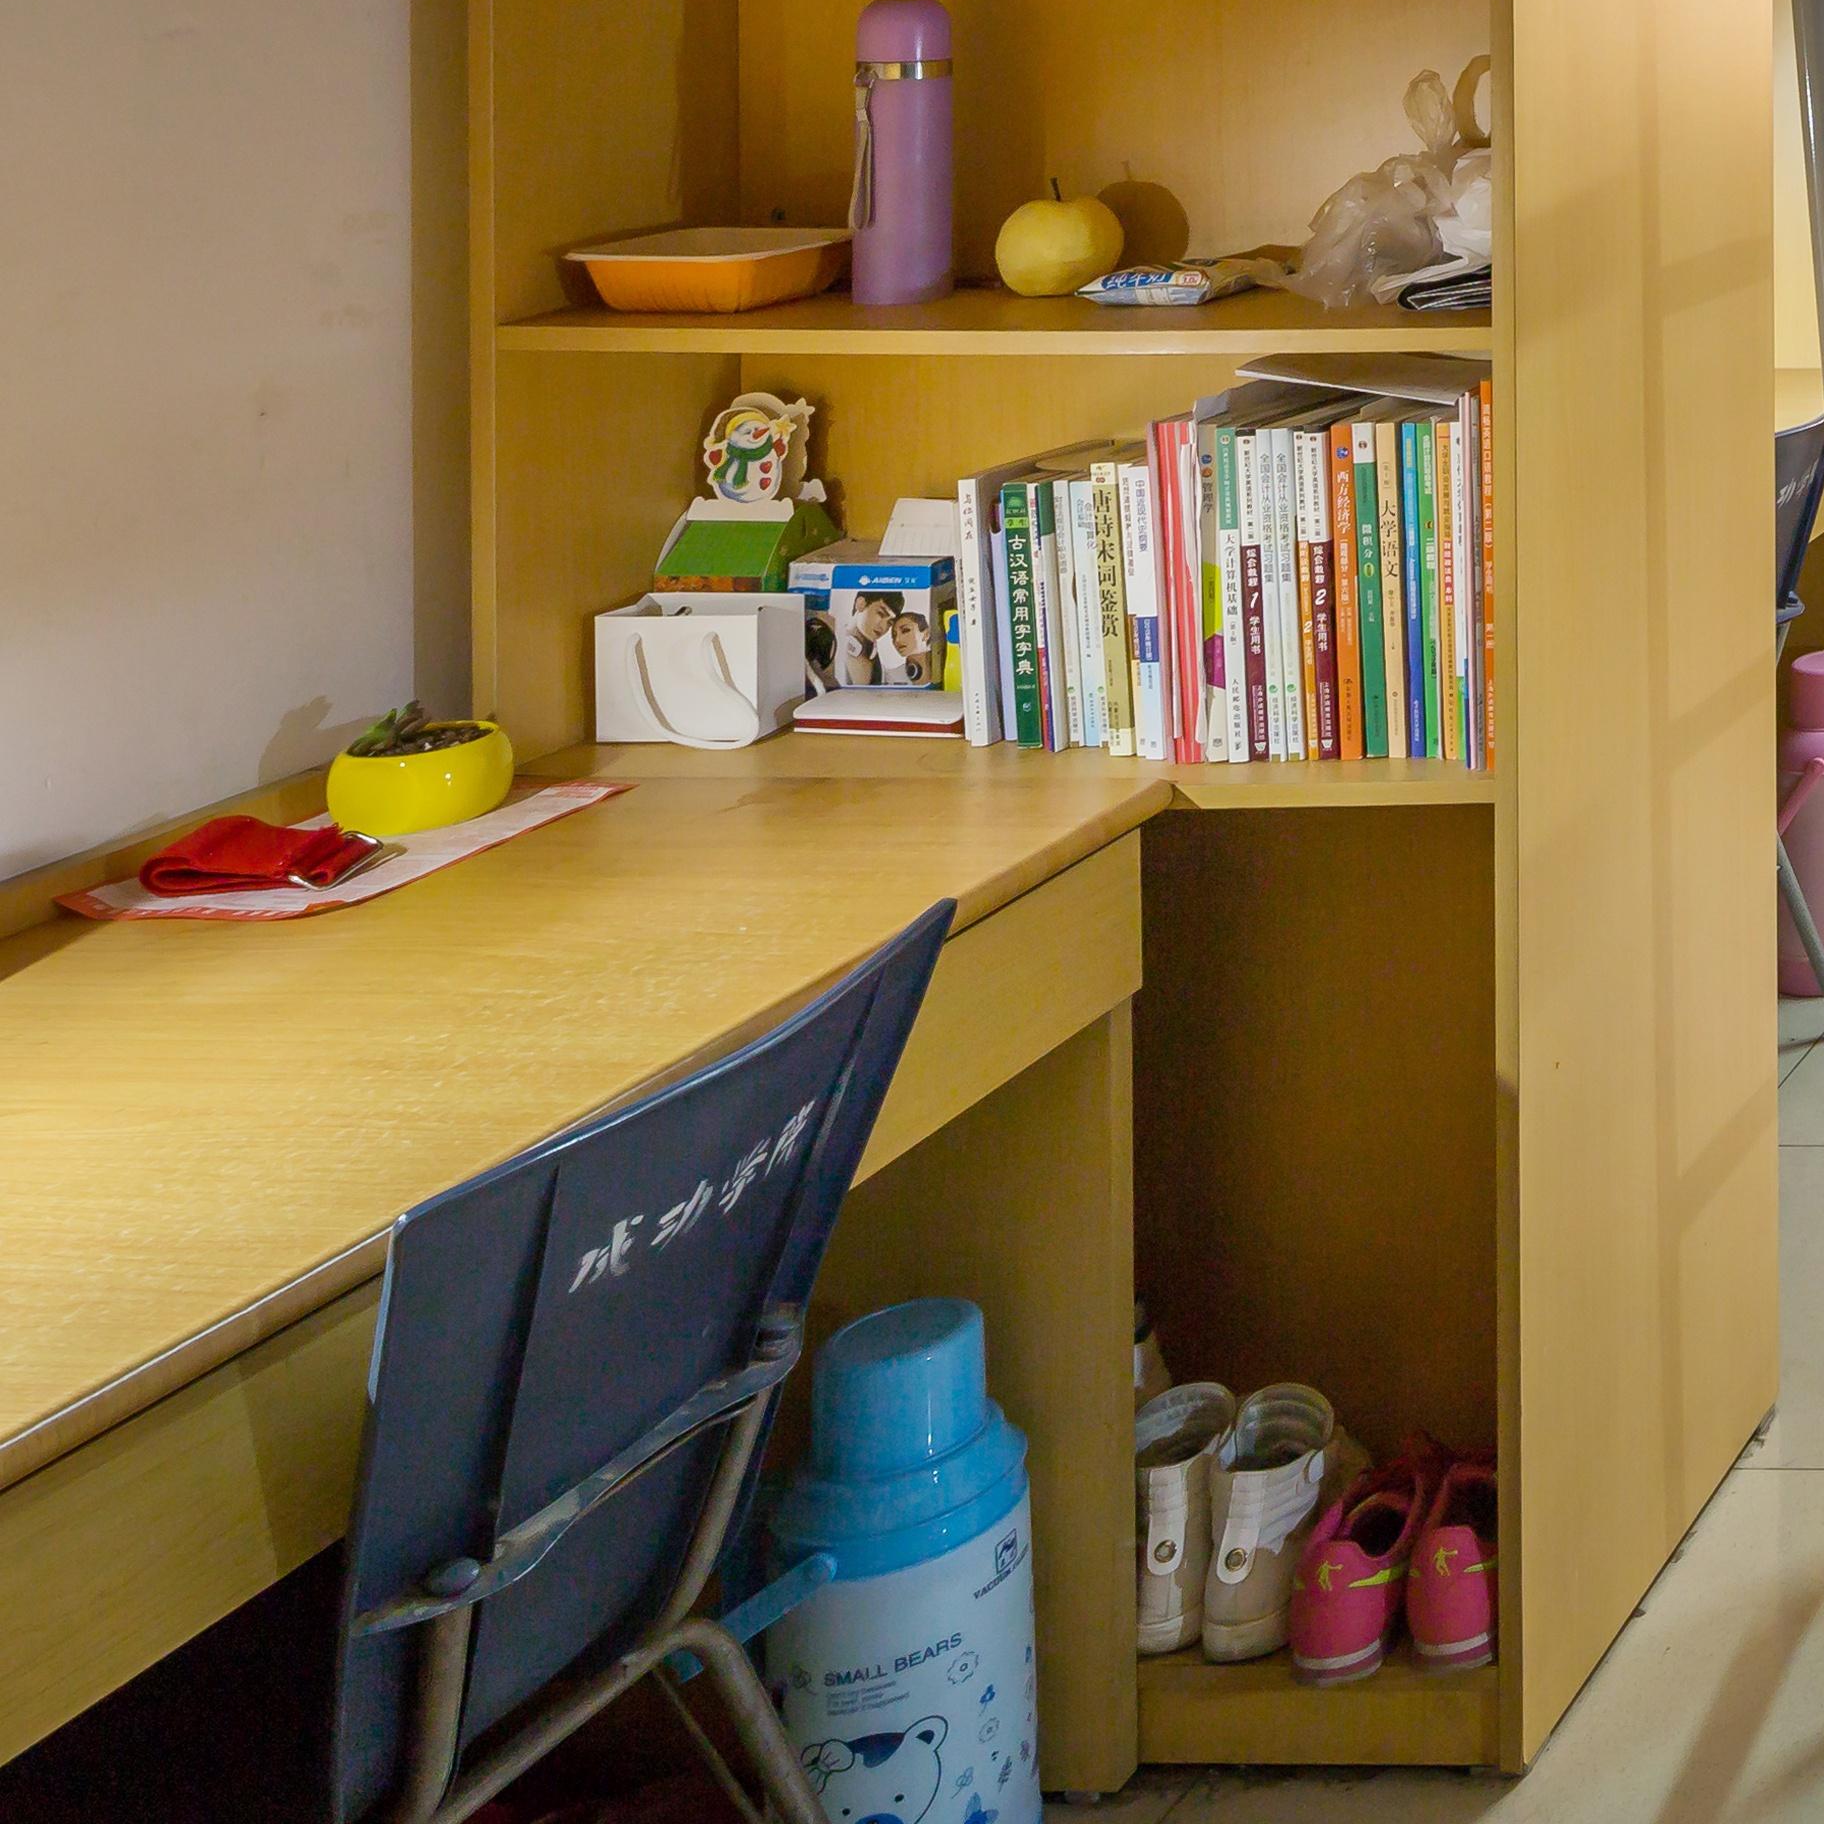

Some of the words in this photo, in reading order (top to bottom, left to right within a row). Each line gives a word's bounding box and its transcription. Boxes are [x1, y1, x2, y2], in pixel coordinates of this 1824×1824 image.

[1336, 470, 1351, 535] 西方经济学
[1361, 523, 1374, 559] 微积分
[1380, 499, 1399, 578] 大学语文
[1224, 533, 1238, 616] 大学计算机基础
[1313, 544, 1325, 584] 综合教程
[1008, 534, 1035, 675] 古汉语常用字字典
[1250, 591, 1259, 609] 1
[1315, 588, 1327, 606] 2
[1249, 615, 1262, 655] 学生用书
[1316, 612, 1328, 653] 学生用书
[823, 1664, 889, 1687] SMALL
[894, 1632, 963, 1672] BEARS
